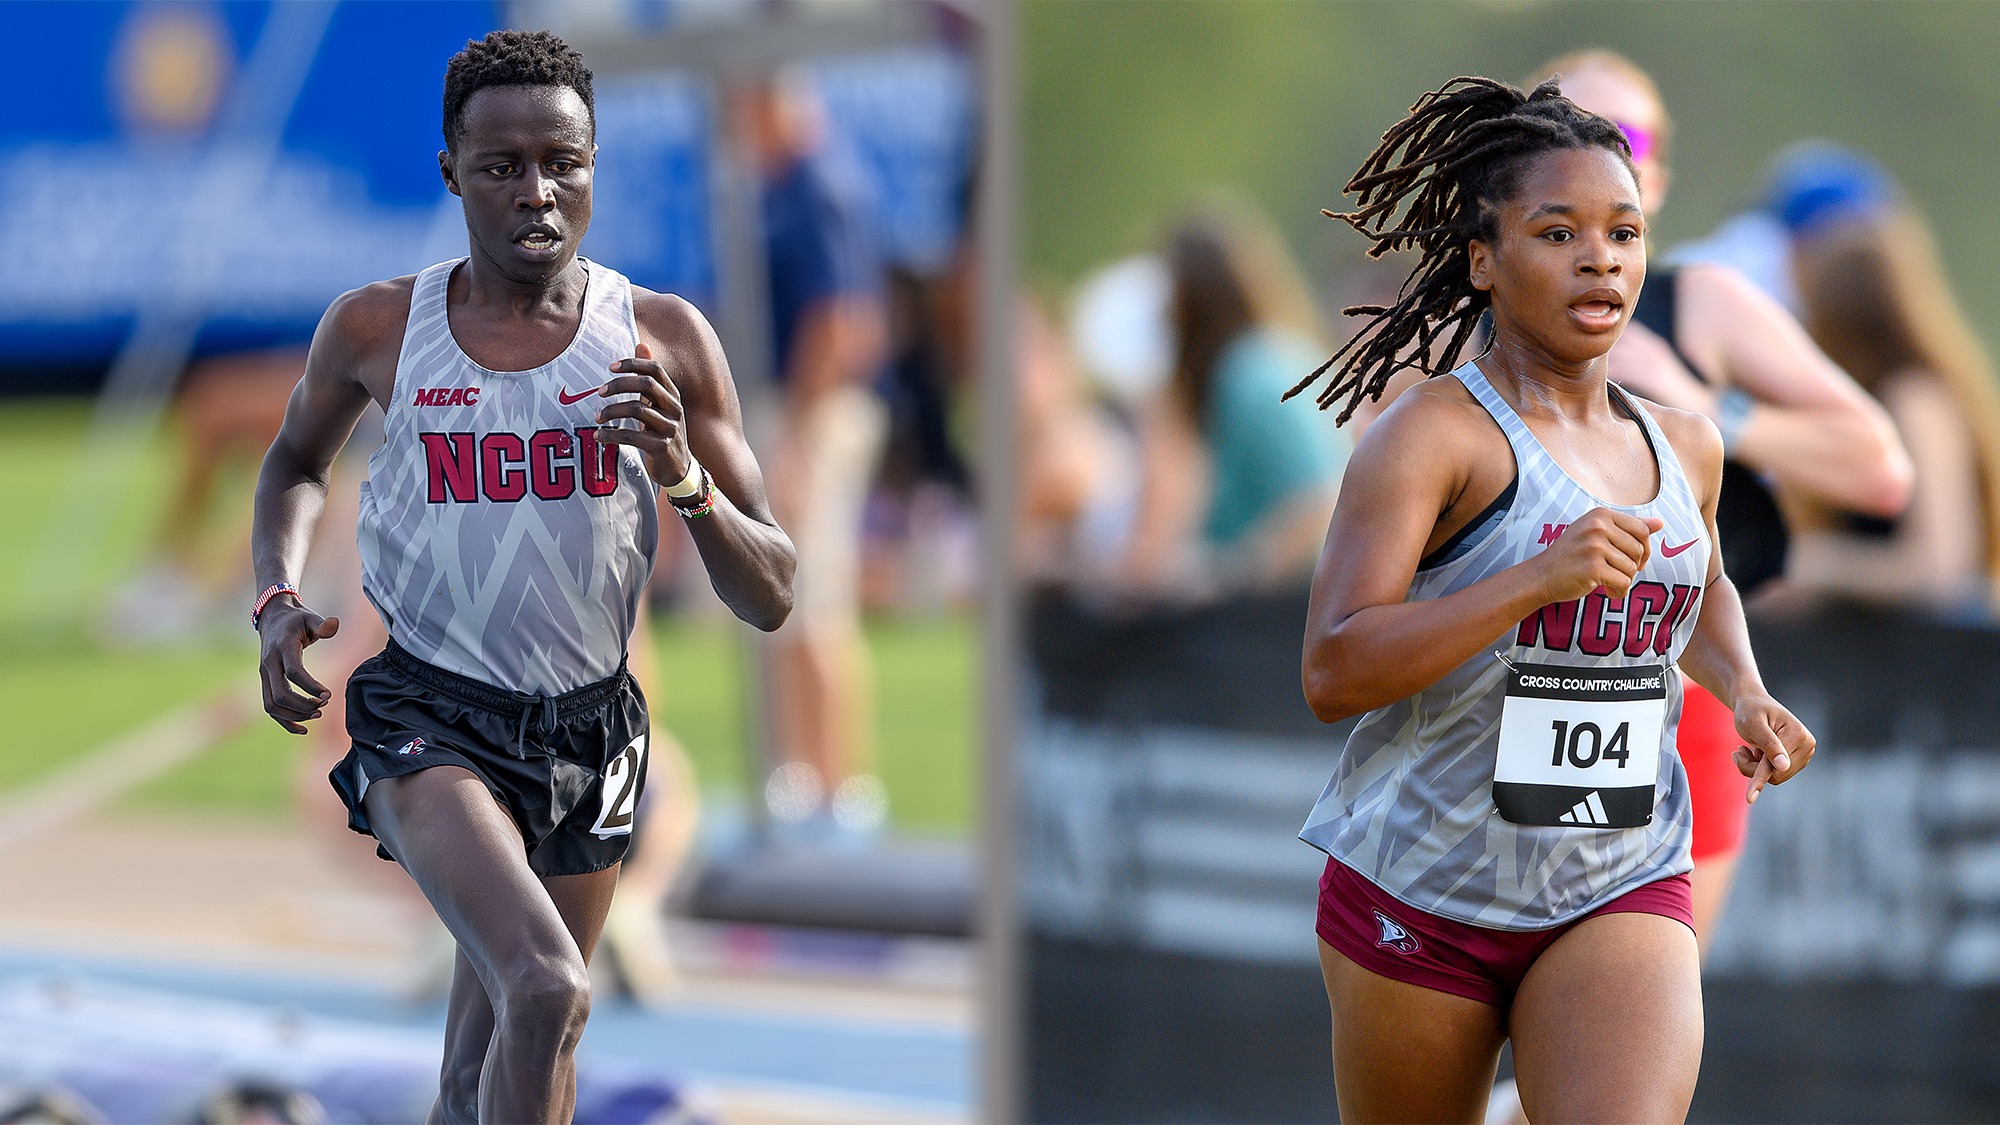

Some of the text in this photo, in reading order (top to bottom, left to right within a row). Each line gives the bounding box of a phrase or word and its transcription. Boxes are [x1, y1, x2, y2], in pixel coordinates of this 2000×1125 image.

[413, 387, 480, 407] MEAC
[419, 426, 620, 503] NCCU
[1519, 675, 1661, 691] CROSS COUNTRY CHALLENGE
[1551, 720, 1630, 769] 104
[599, 746, 633, 829] 2
